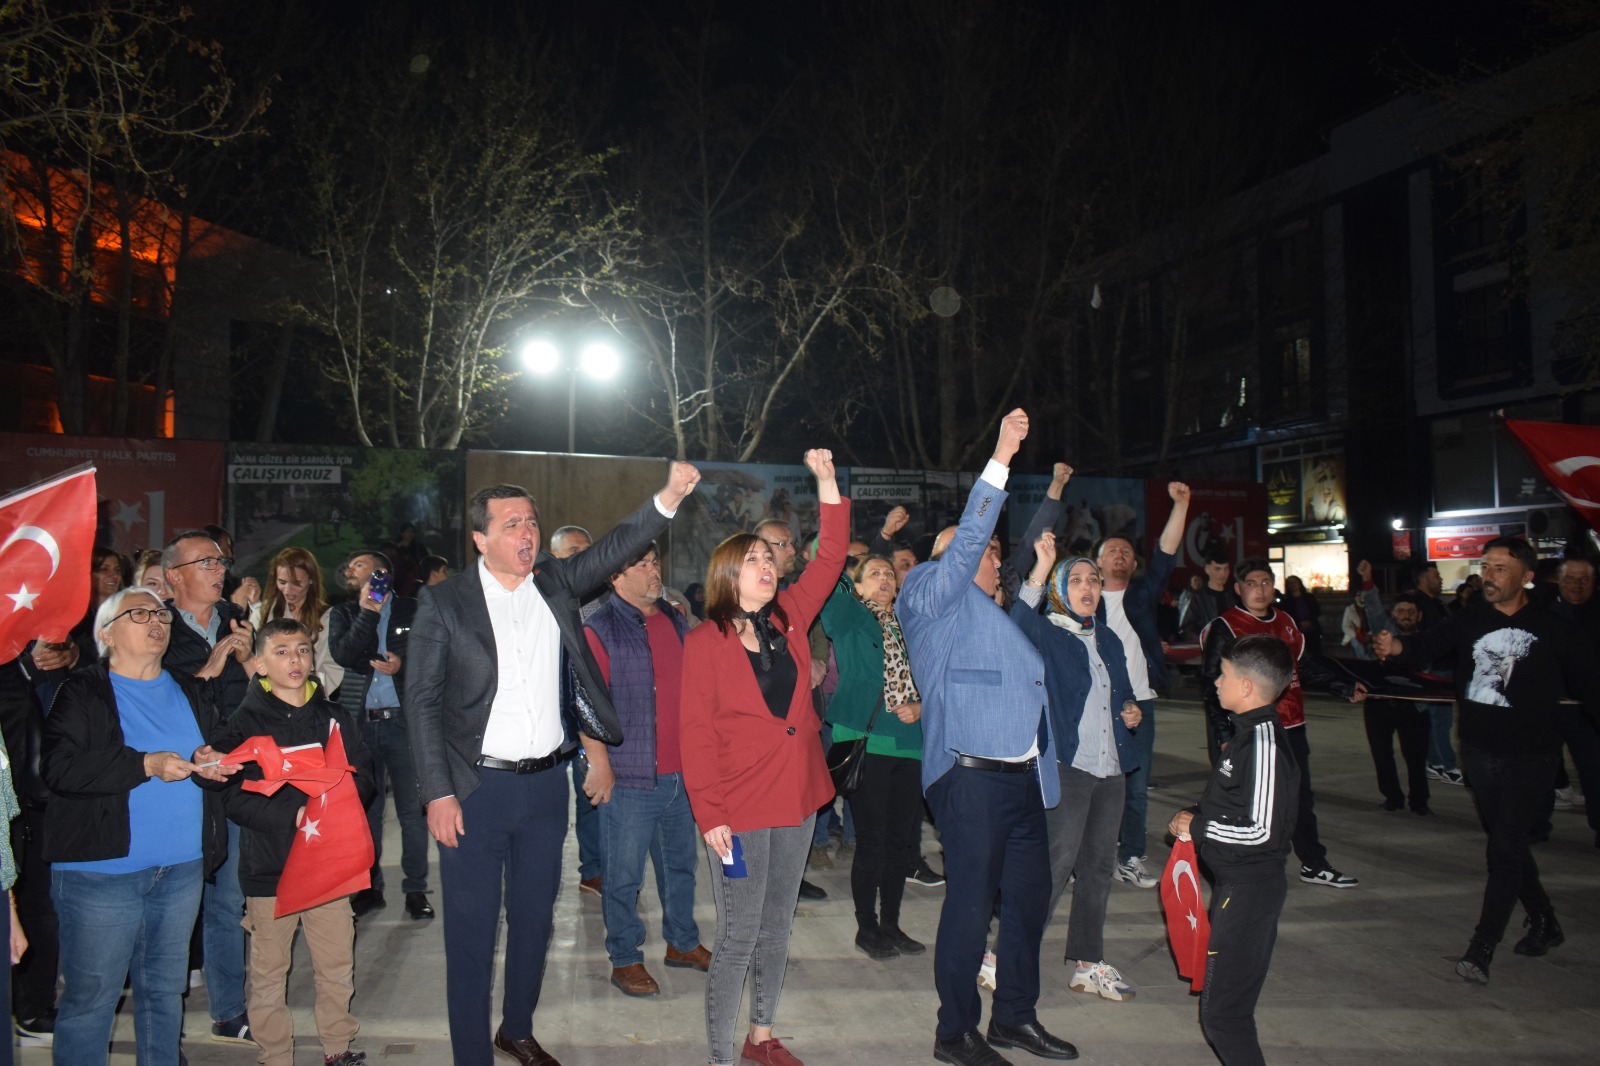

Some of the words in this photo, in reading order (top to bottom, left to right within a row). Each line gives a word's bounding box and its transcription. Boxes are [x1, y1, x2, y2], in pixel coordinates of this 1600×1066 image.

[103, 450, 133, 460] HALK
[233, 454, 257, 464] DAHA
[258, 454, 283, 464] GÜZEL
[233, 468, 332, 482] ÇALIŞIYORUZ
[857, 487, 912, 499] ÇALIŞIYORUZ
